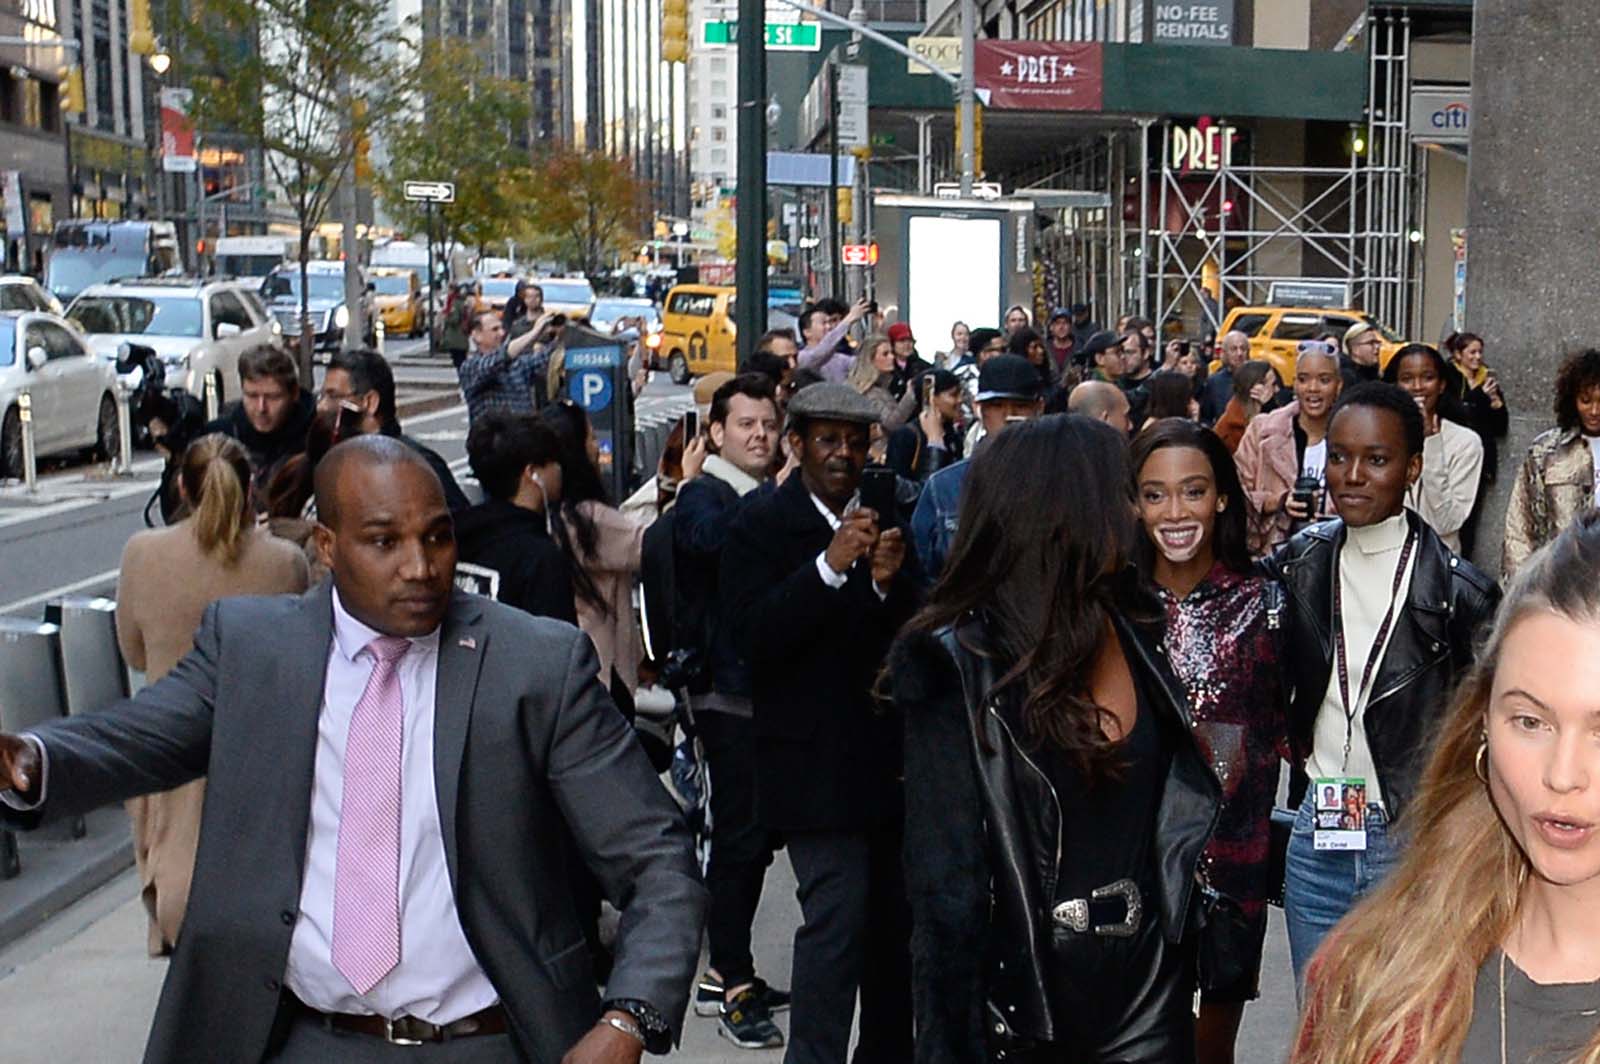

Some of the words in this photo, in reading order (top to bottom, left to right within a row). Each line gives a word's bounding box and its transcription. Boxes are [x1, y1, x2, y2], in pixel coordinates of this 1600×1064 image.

[775, 26, 792, 44] St
[1156, 22, 1229, 39] RENTALS
[1018, 55, 1060, 83] PRET
[1431, 107, 1467, 128] citi
[1173, 125, 1237, 170] PRET
[583, 373, 604, 407] P
